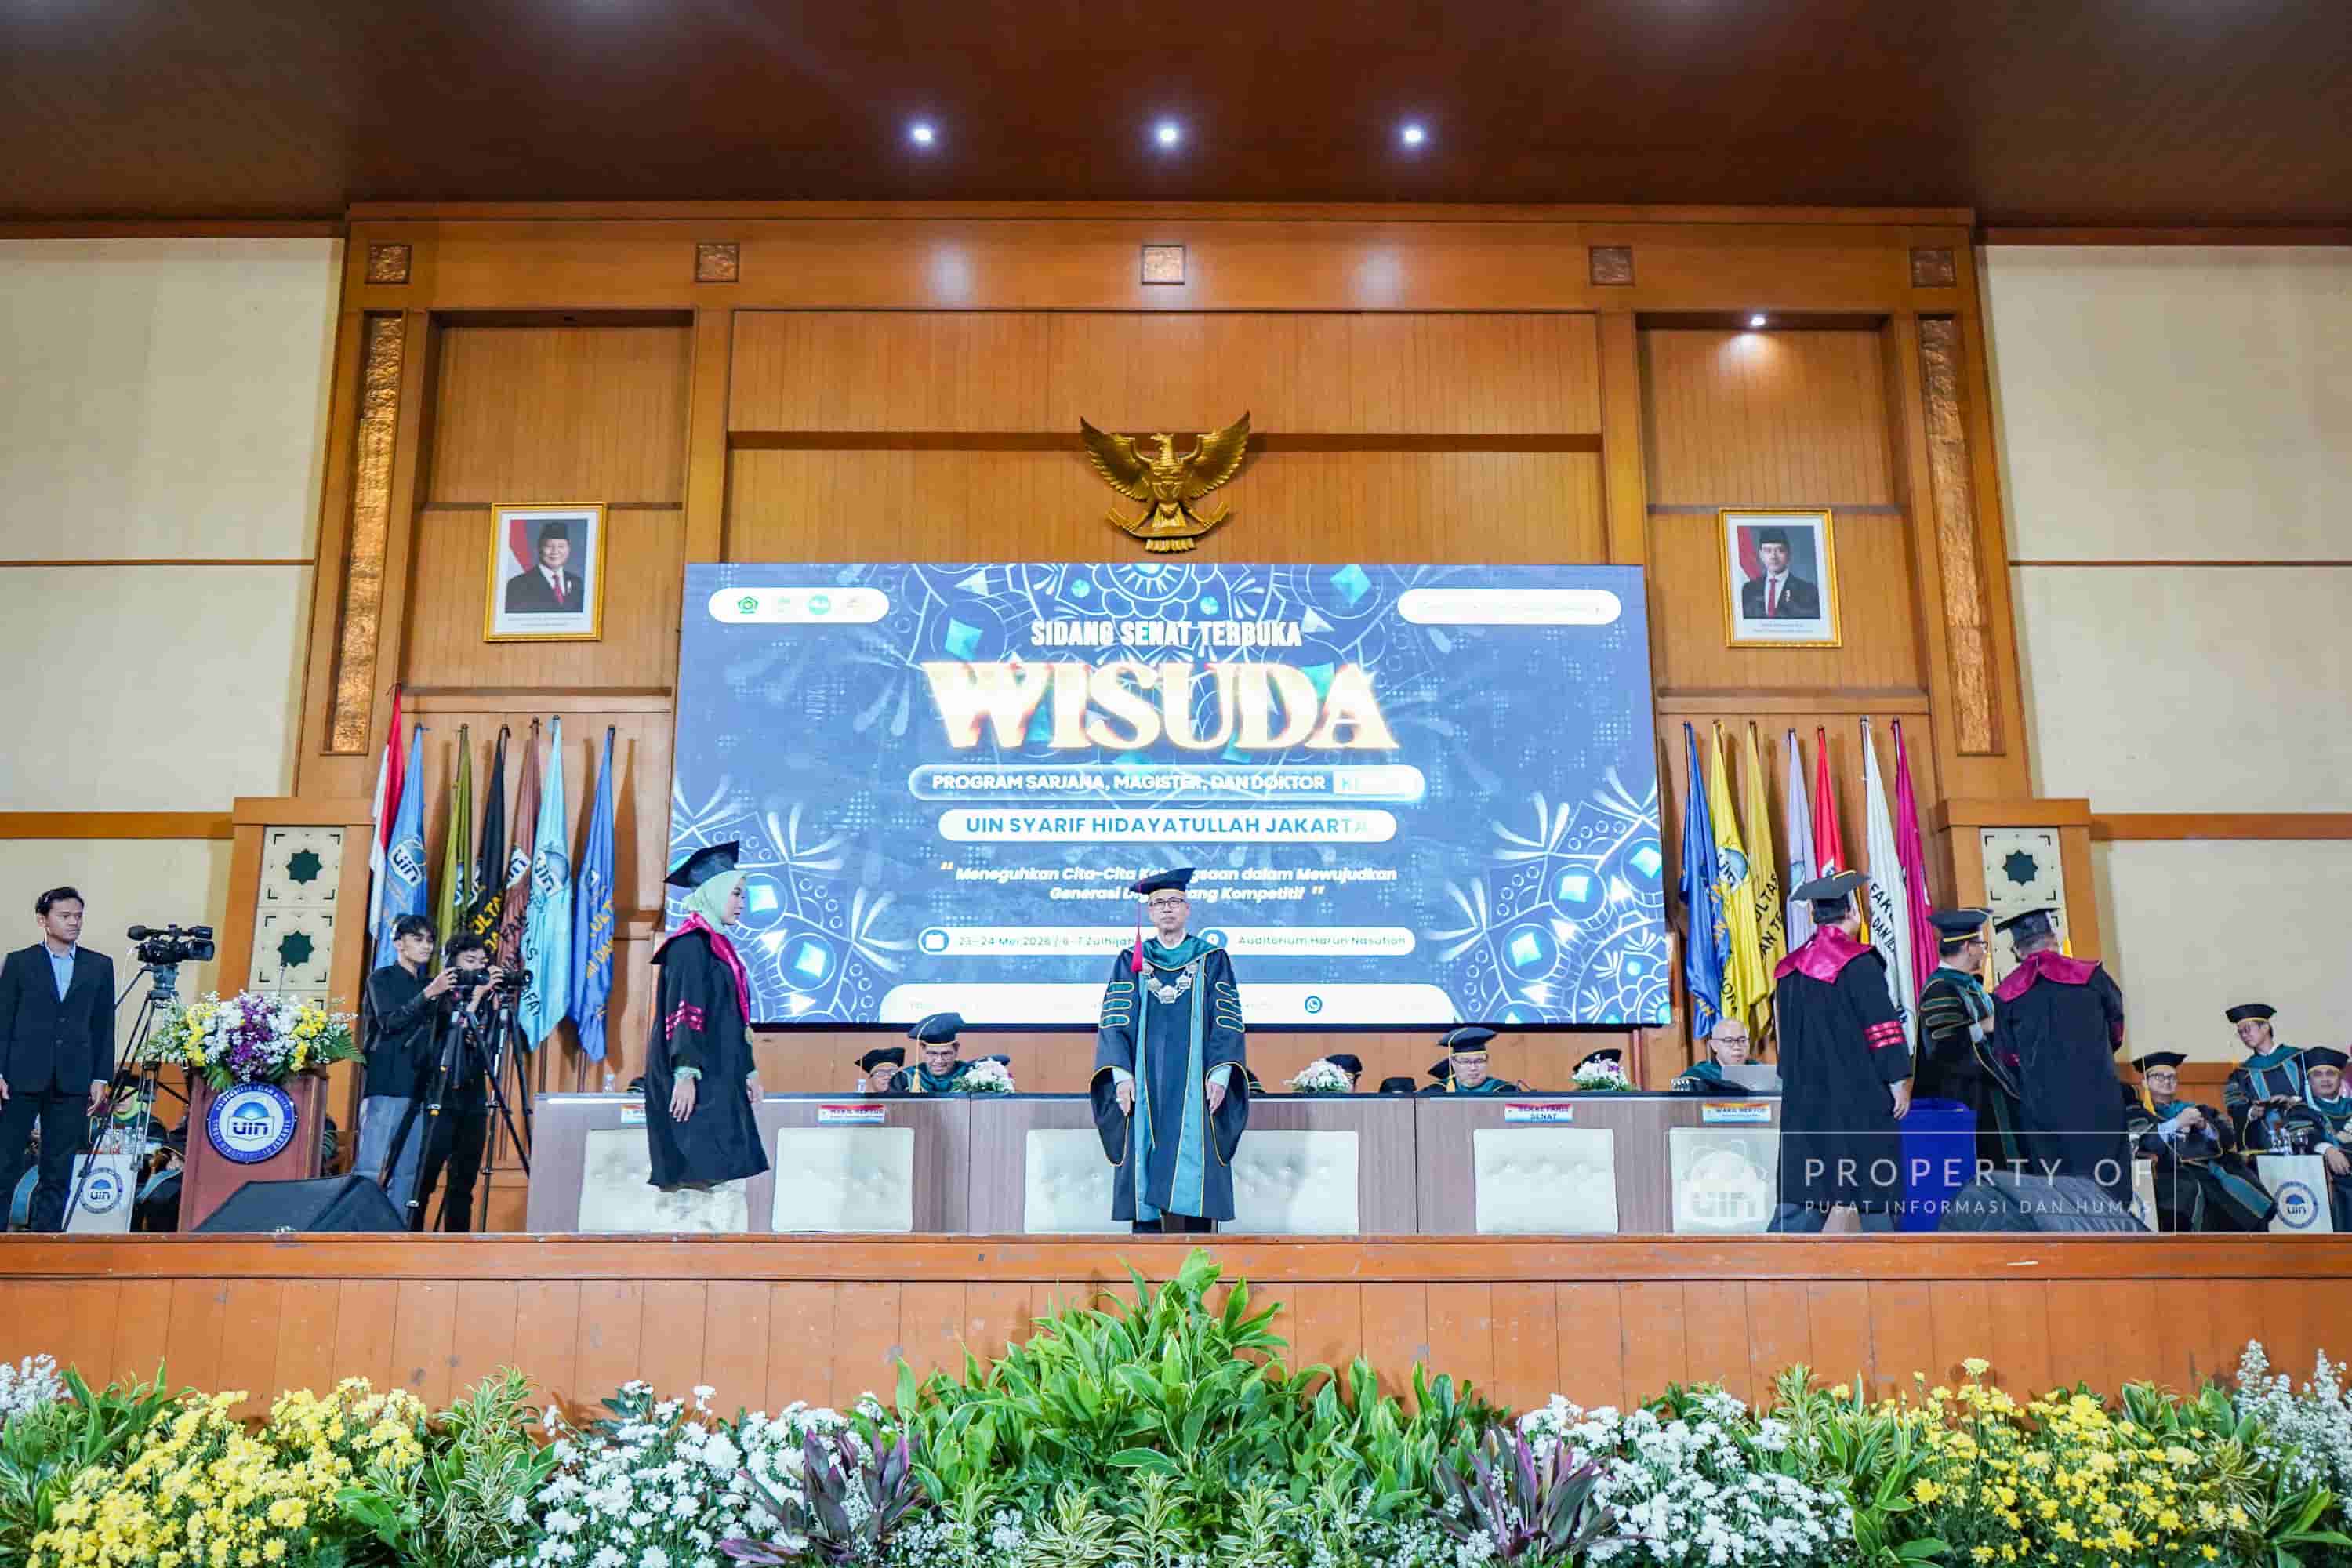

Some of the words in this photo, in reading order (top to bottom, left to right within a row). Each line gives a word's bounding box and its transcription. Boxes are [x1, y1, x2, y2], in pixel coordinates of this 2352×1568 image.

[1120, 620, 1192, 646] SENAT
[1199, 620, 1302, 646] TERBUKA
[920, 661, 1400, 750] WISUDA
[932, 775, 1022, 790] PROGRAM
[1025, 775, 1110, 792] SARJANA,
[1210, 775, 1254, 790] DAN
[1255, 775, 1326, 790] DOKTOR
[966, 817, 1004, 833] UIN
[1010, 817, 1086, 833] SYARIF
[1092, 817, 1259, 833] HIDAYATULLAH
[1265, 817, 1368, 833] JAKARTA
[956, 867, 1059, 884] Meneguhkan
[1062, 867, 1136, 880] Cita-Cita
[1241, 868, 1293, 880] dalam
[1296, 868, 1397, 884] Mewujudkan
[1050, 887, 1120, 901] Generasi
[1221, 885, 1305, 903] Kompetitif
